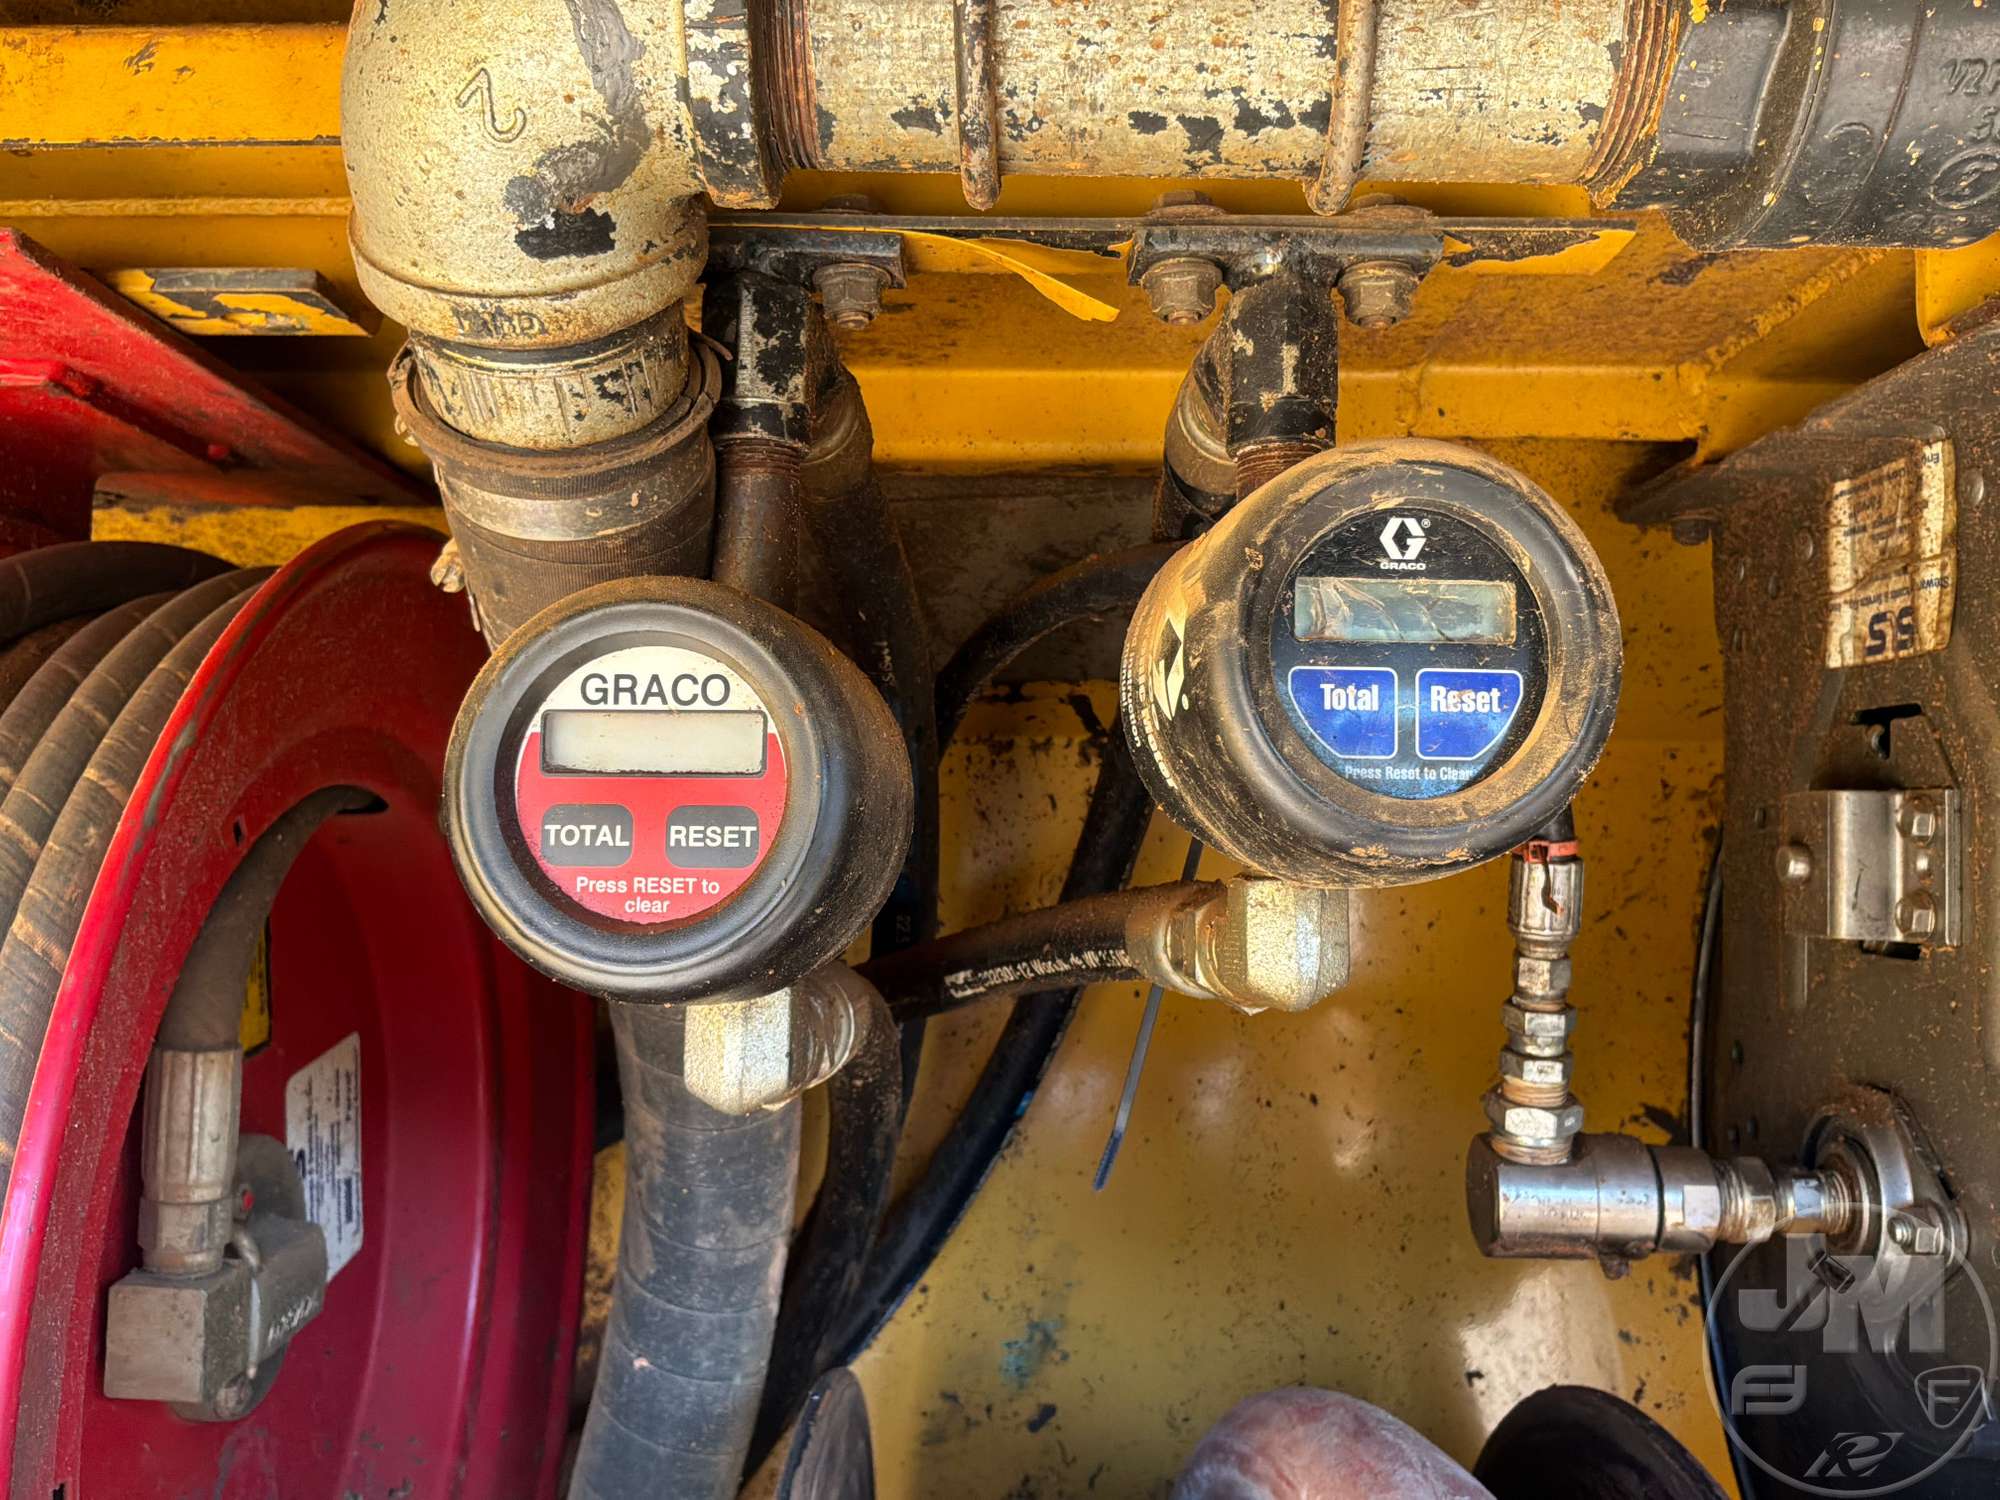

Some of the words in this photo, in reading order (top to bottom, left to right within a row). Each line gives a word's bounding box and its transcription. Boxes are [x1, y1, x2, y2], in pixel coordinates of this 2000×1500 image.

[1380, 562, 1426, 571] GRACO
[580, 673, 731, 707] GRACO
[1320, 683, 1379, 711] Total
[1430, 685, 1500, 713] Reset
[1345, 766, 1381, 779] Press
[1385, 766, 1420, 780] Reset
[1423, 767, 1437, 780] to
[1439, 767, 1474, 781] Clear
[544, 825, 630, 847] TOTAL
[669, 825, 758, 848] RESET
[576, 876, 628, 894] Press
[633, 877, 697, 894] RESET
[702, 878, 720, 895] to
[624, 898, 670, 913] clear
